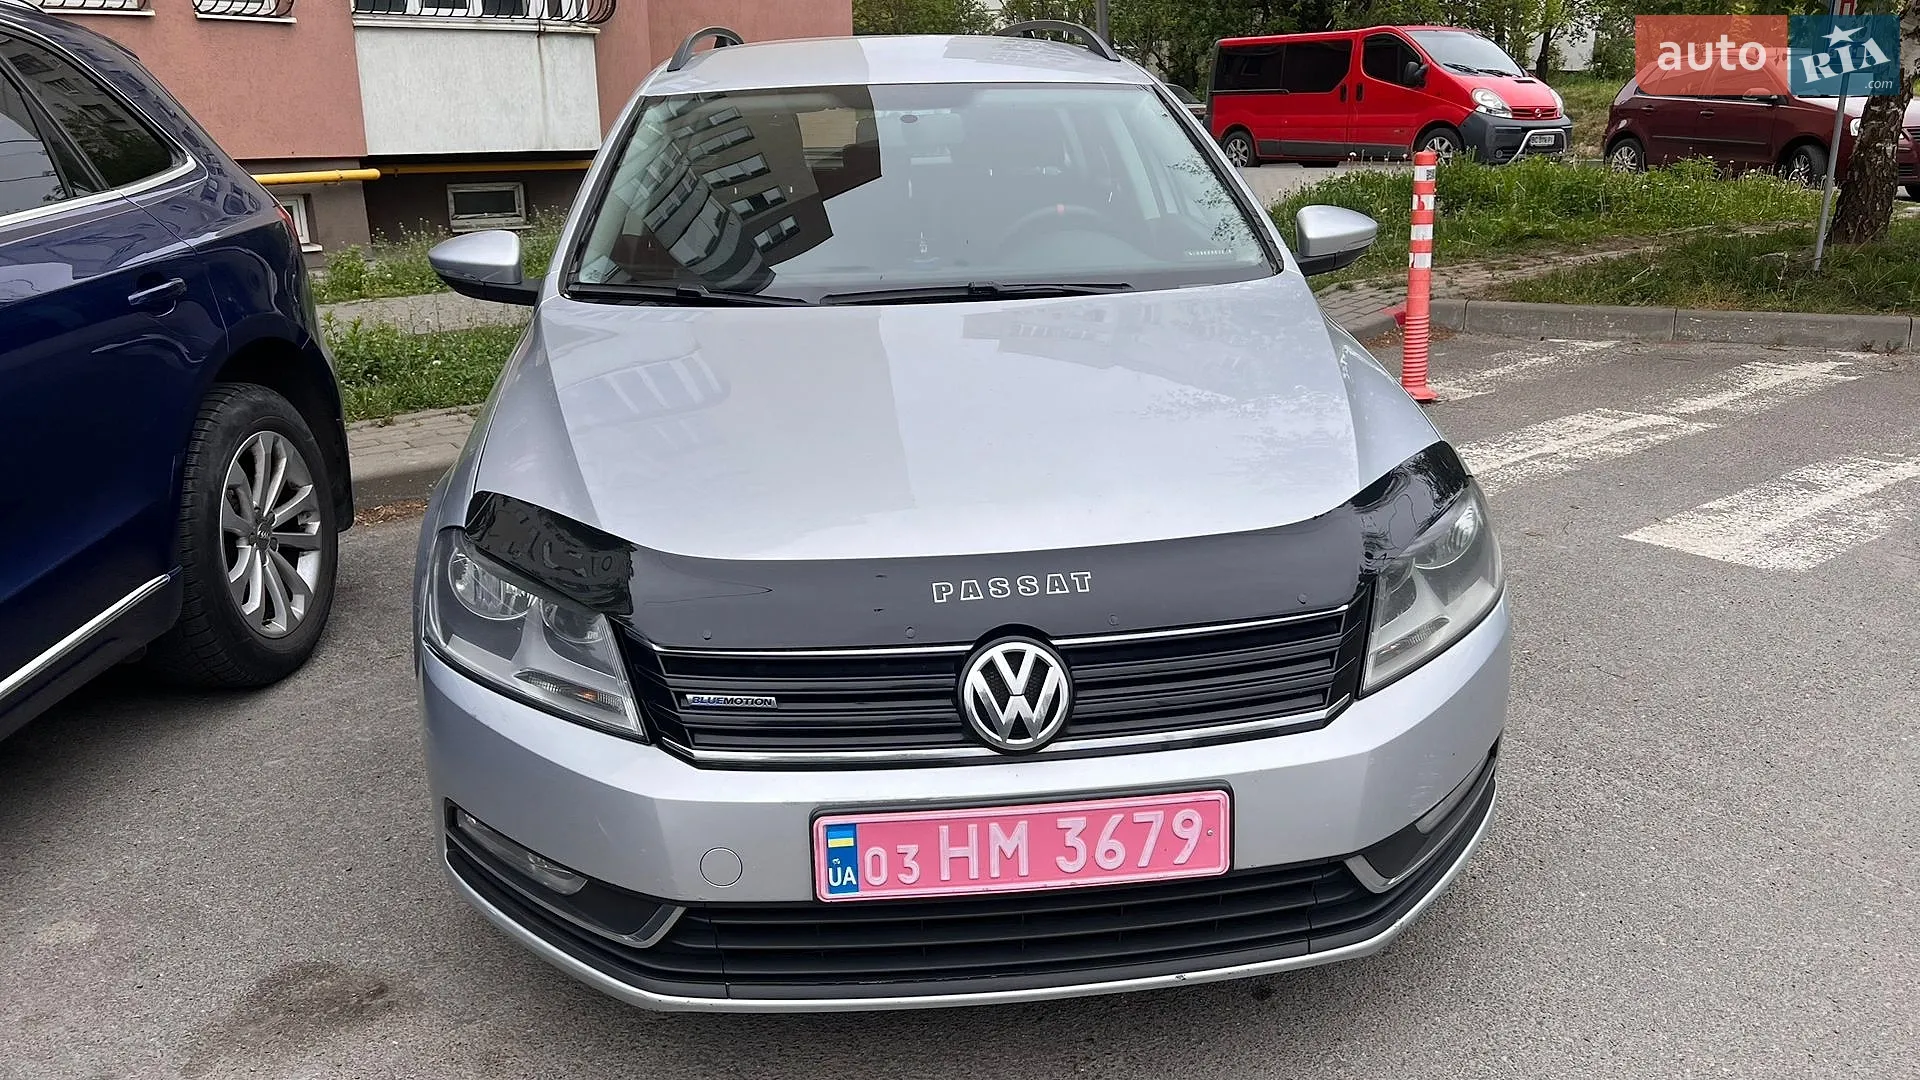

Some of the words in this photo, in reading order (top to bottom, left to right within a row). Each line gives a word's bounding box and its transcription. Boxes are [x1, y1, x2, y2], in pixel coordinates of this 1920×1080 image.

[932, 571, 1092, 603] PASSAT
[692, 696, 772, 706] BLUEMOTION
[963, 641, 1069, 745] VW
[864, 844, 920, 887] 03
[939, 820, 1029, 881] HM
[1055, 808, 1203, 874] 3679
[828, 866, 857, 887] UA
